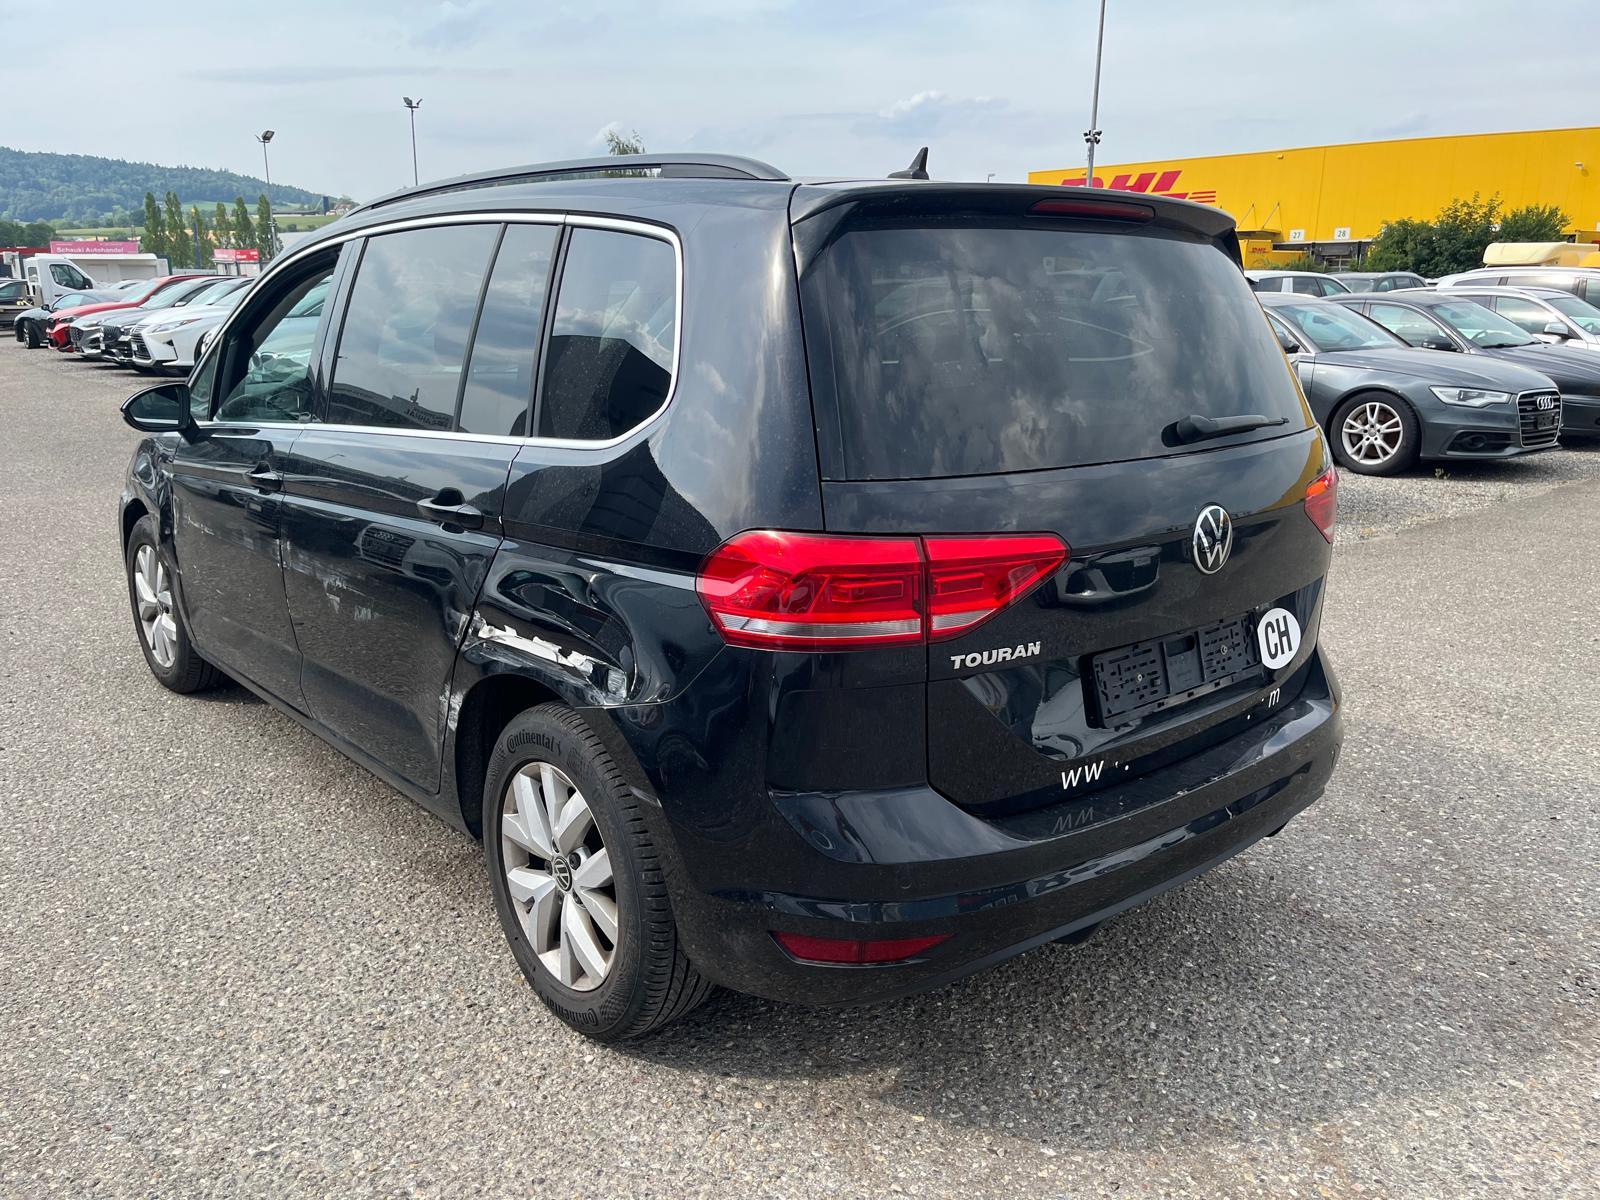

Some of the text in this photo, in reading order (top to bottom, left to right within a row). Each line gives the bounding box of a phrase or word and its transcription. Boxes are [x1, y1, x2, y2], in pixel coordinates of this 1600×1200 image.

[1292, 231, 1301, 239] 27
[1264, 615, 1293, 660] CH
[950, 641, 1041, 670] TOURAN
[506, 728, 556, 754] Continental
